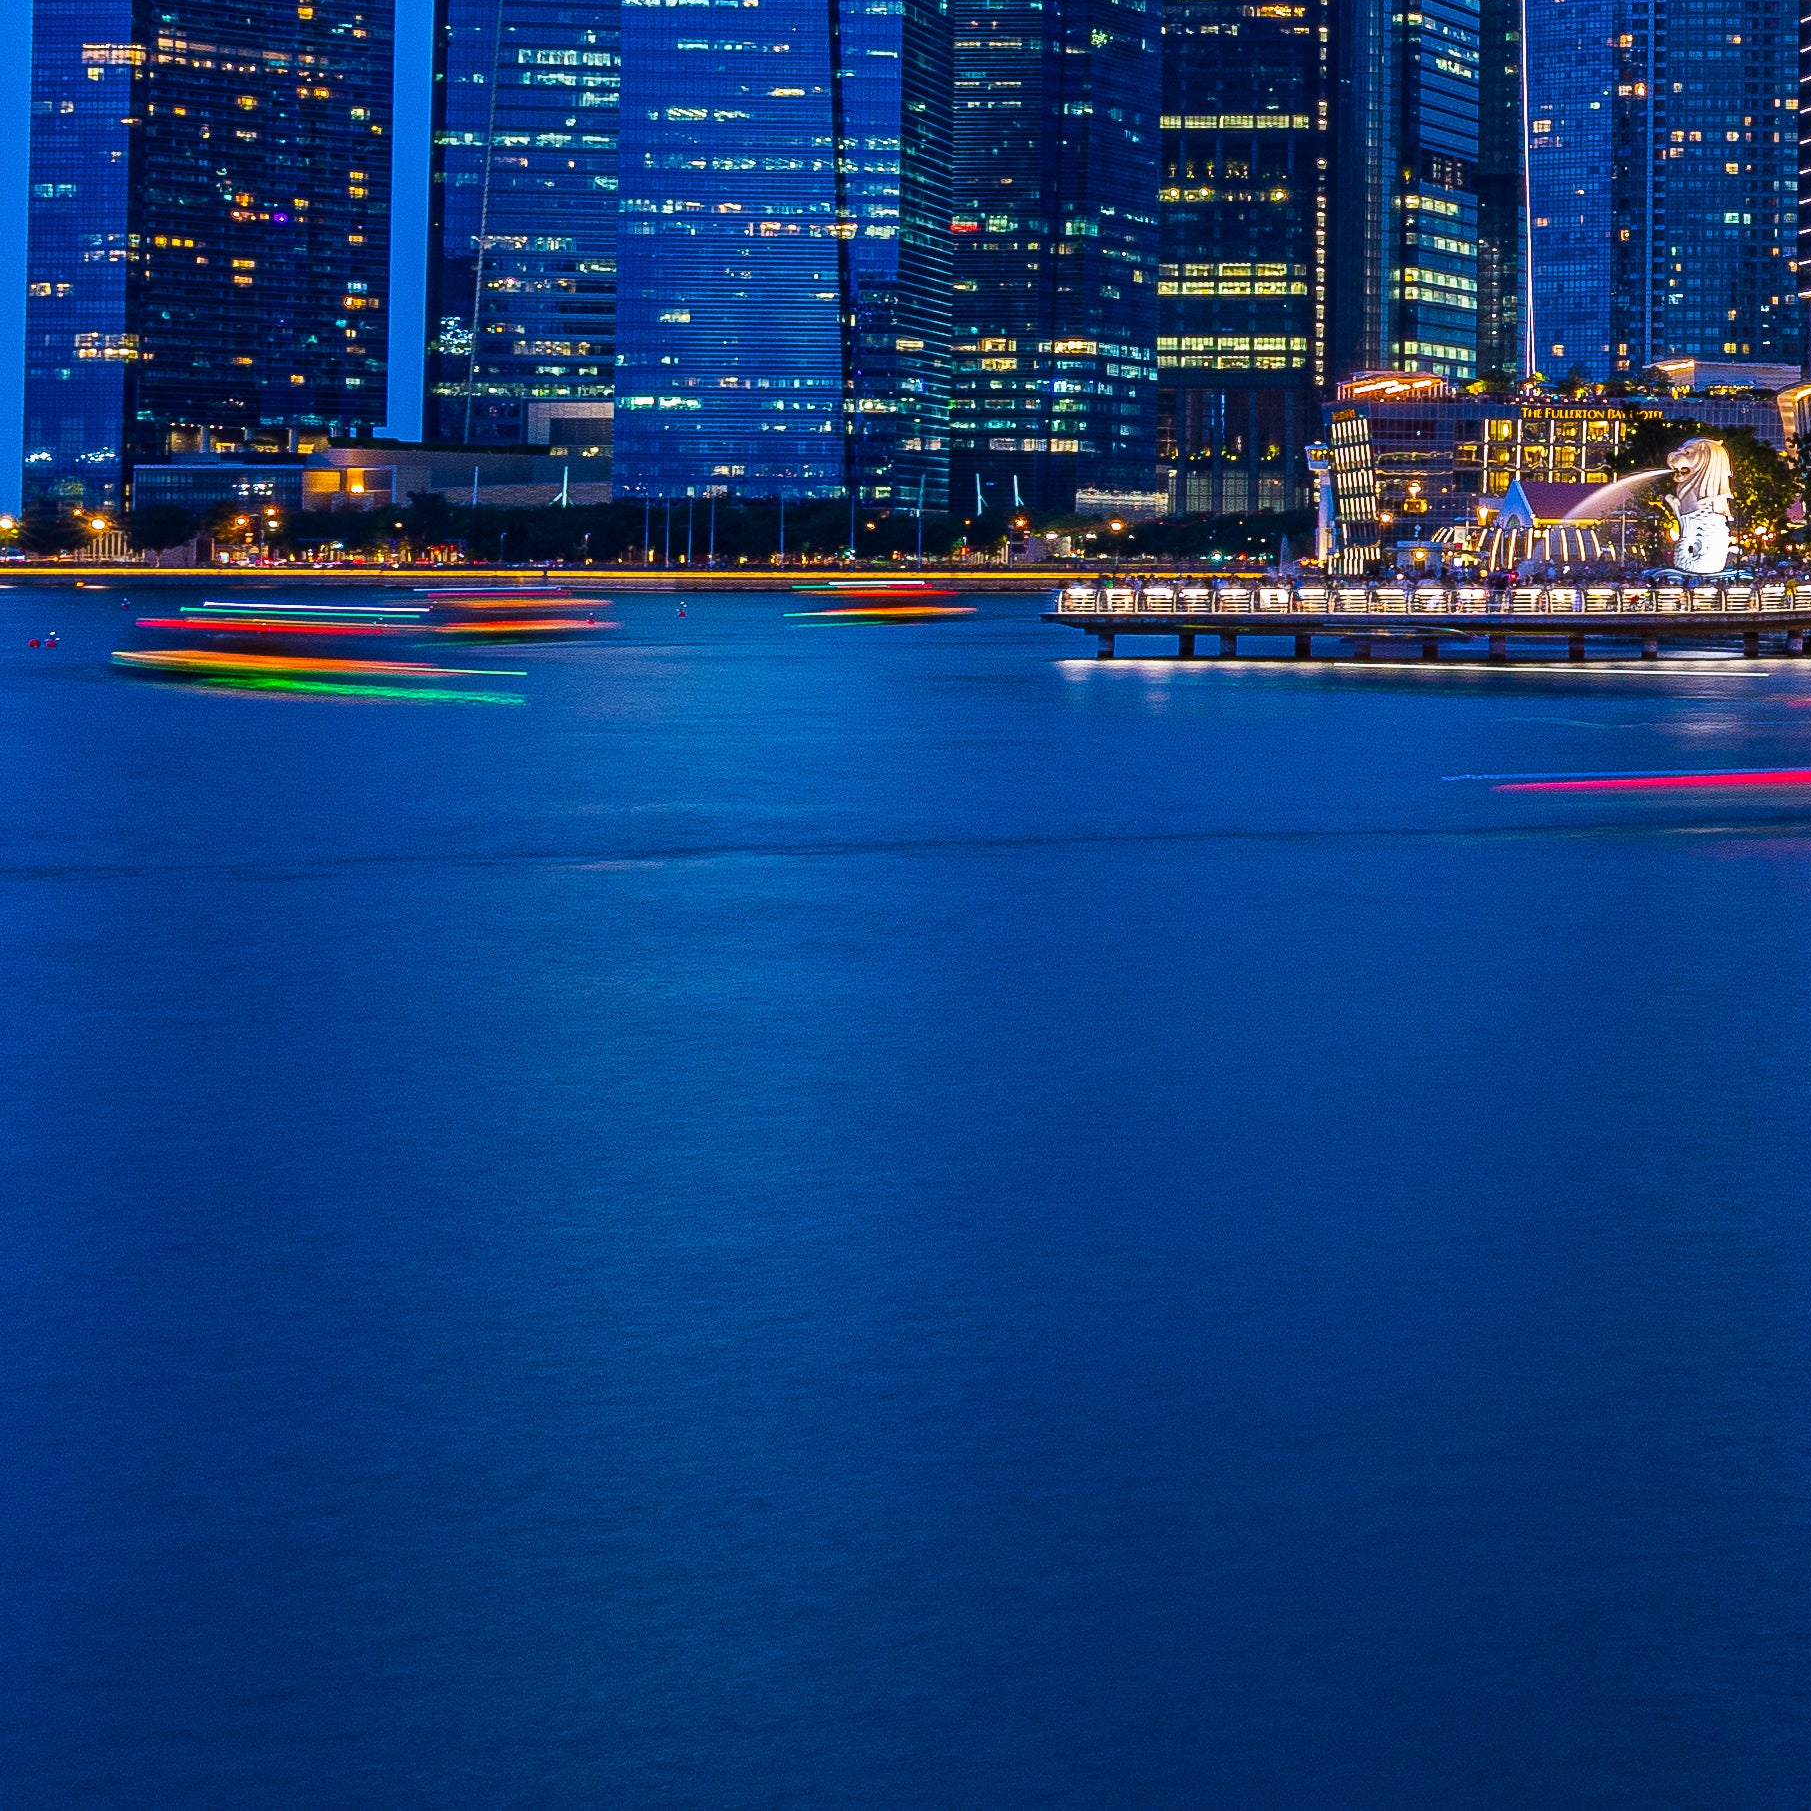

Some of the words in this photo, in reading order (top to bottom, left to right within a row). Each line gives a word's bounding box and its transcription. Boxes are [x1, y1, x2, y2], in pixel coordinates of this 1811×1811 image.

[1521, 407, 1543, 419] THE
[1544, 407, 1605, 420] FULLERTON
[1628, 409, 1663, 421] OTEL
